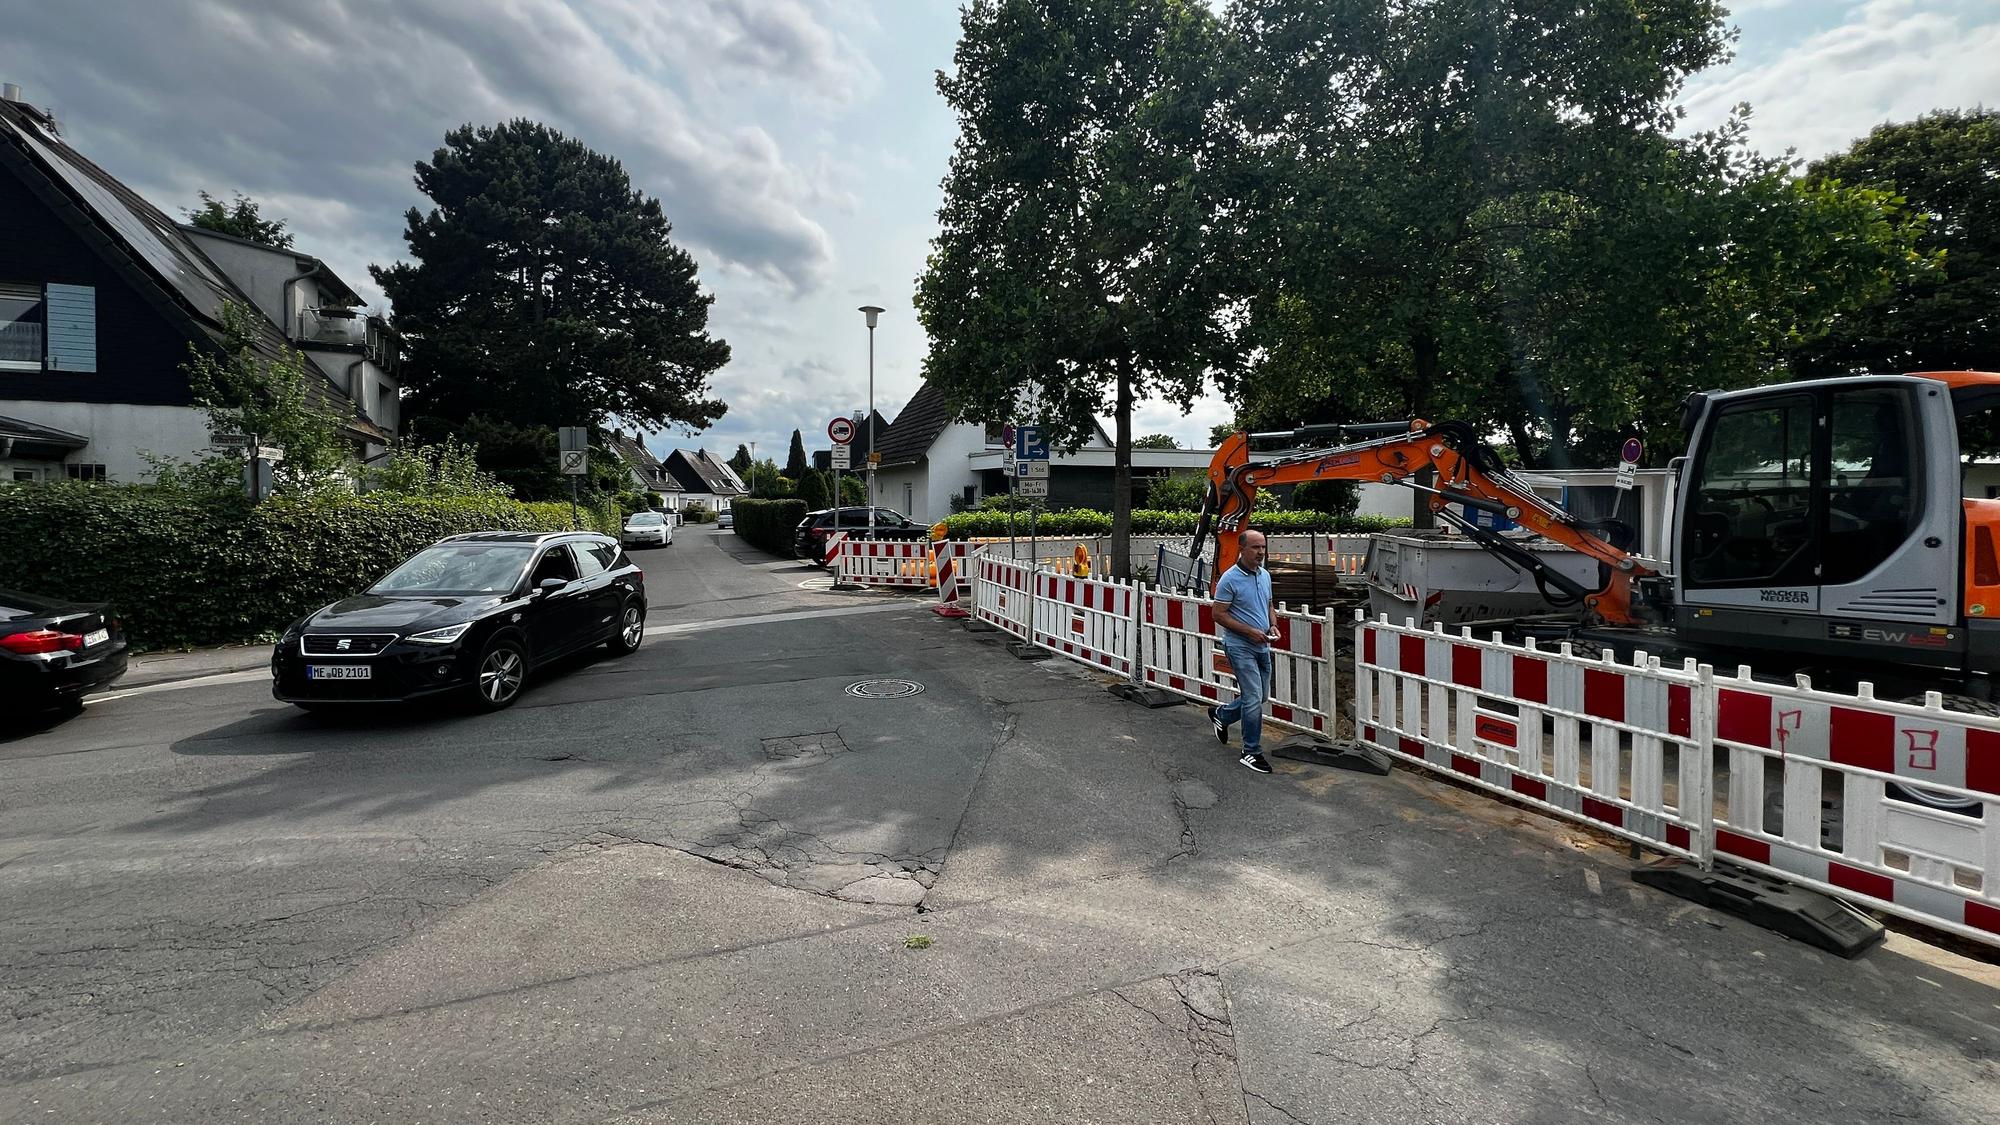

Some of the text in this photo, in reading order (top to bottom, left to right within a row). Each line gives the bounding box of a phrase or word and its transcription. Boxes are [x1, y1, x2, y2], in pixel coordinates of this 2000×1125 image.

[1024, 430, 1041, 455] P
[1760, 589, 1808, 598] WACKER
[1760, 595, 1809, 604] NEUSON
[313, 667, 369, 678] ME QB 2101
